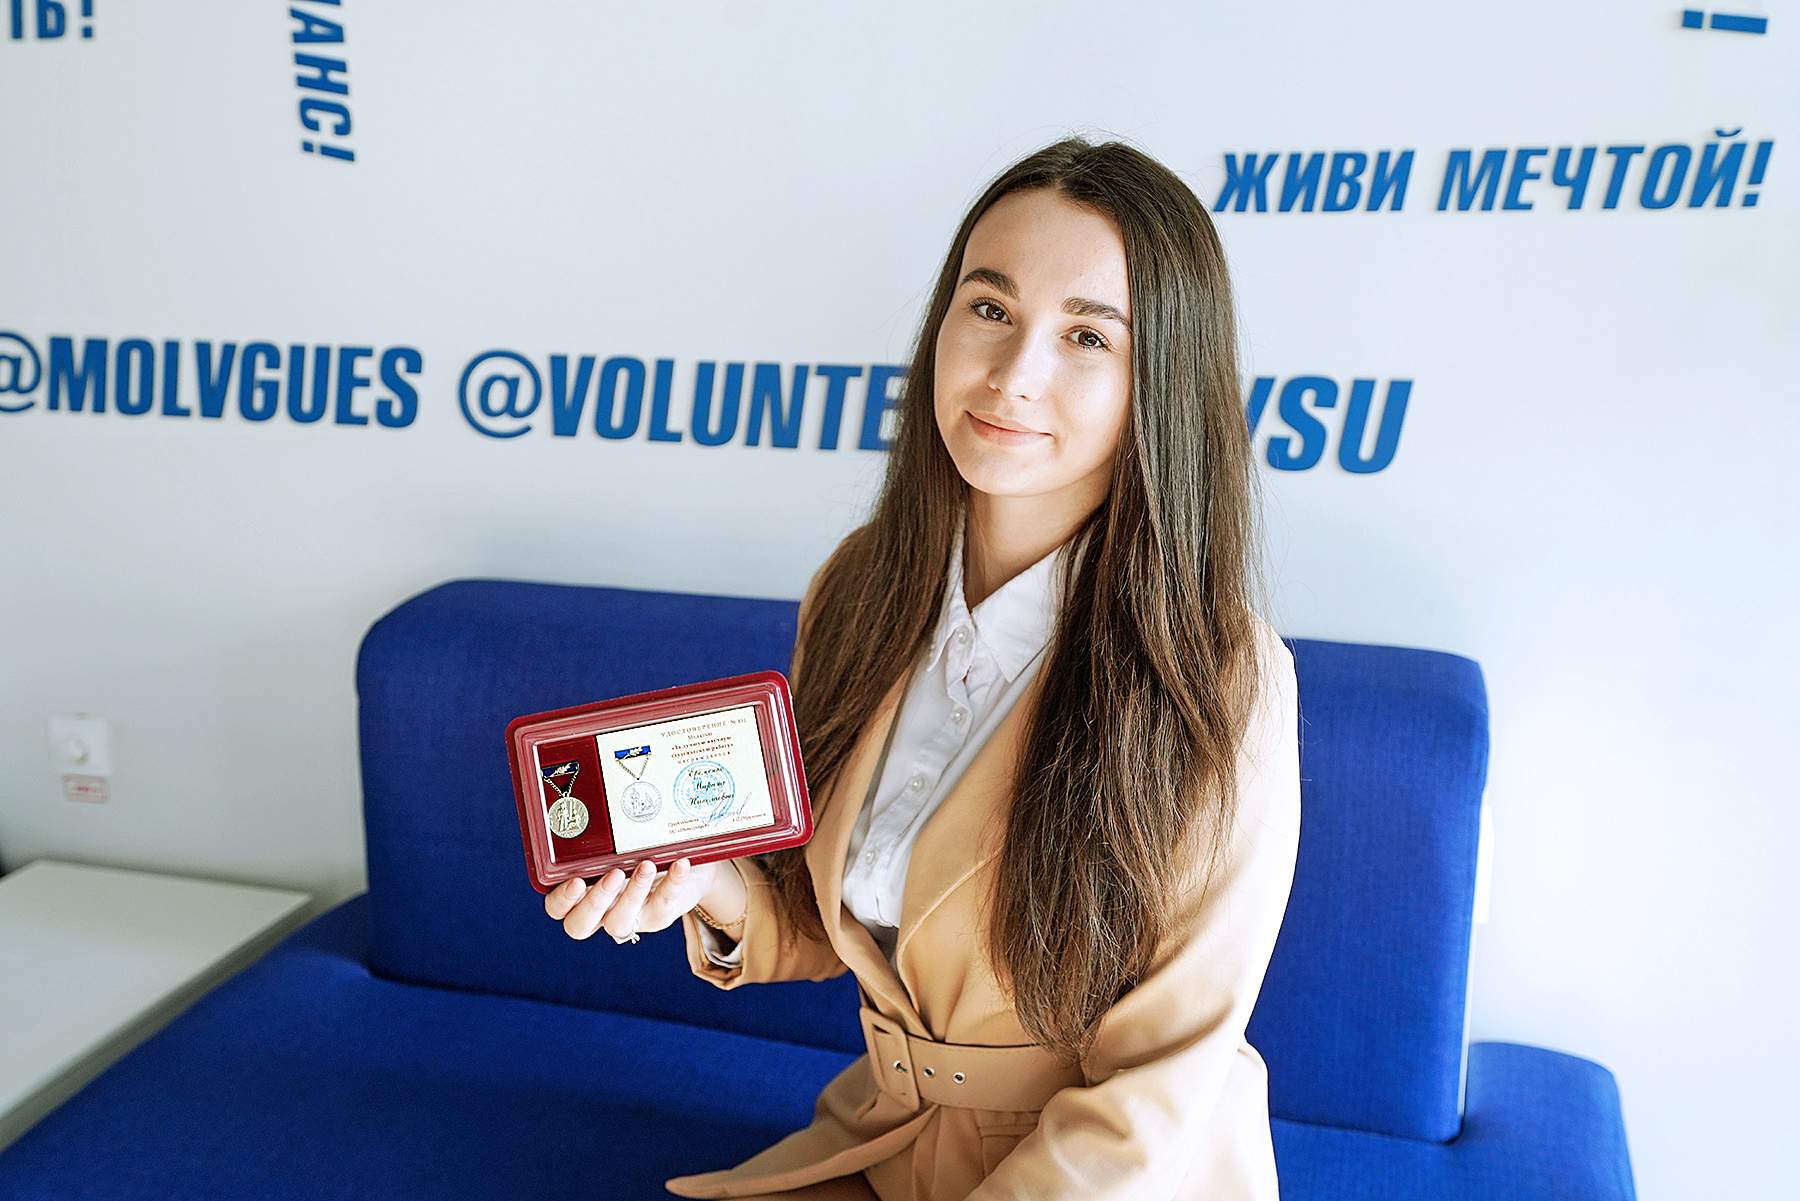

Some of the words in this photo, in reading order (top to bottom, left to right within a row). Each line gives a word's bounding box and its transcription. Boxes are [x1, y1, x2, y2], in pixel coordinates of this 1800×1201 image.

[289, 0, 355, 161] АНС!
[1213, 149, 1415, 213] ЖИВИ
[1437, 127, 1775, 212] МЕЧТОЙ!
